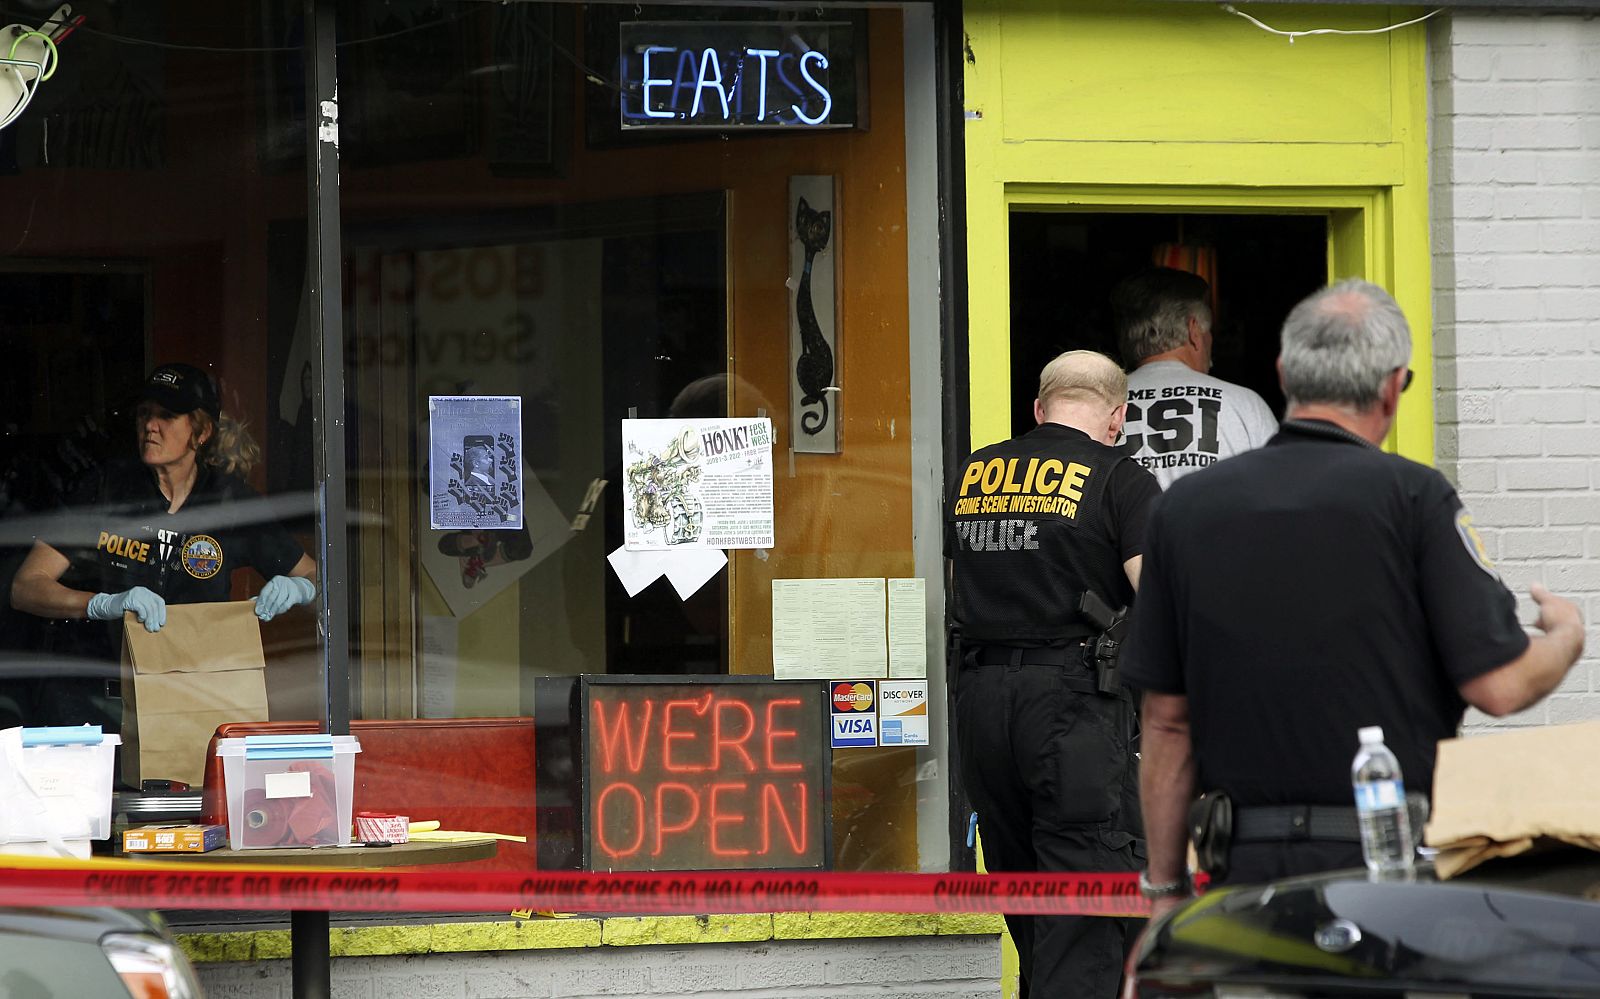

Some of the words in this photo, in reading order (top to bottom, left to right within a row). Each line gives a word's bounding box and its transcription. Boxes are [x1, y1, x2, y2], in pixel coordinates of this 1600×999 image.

[643, 47, 832, 125] EATS
[1161, 386, 1222, 399] SCENE
[702, 425, 749, 457] HONK!
[749, 421, 767, 437] fest
[751, 433, 770, 447] west
[959, 457, 1091, 502] POLICE
[954, 497, 980, 516] CRIME
[980, 496, 1010, 514] SCENE
[1008, 495, 1078, 520] INVESTIGATOR
[97, 531, 150, 563] POLICE
[955, 519, 1040, 551] POLICE
[834, 693, 872, 702] MasterCard
[883, 690, 924, 700] DISCOVER
[593, 692, 804, 774] WE'RE
[836, 718, 873, 733] VISA
[597, 781, 809, 859] OPEN
